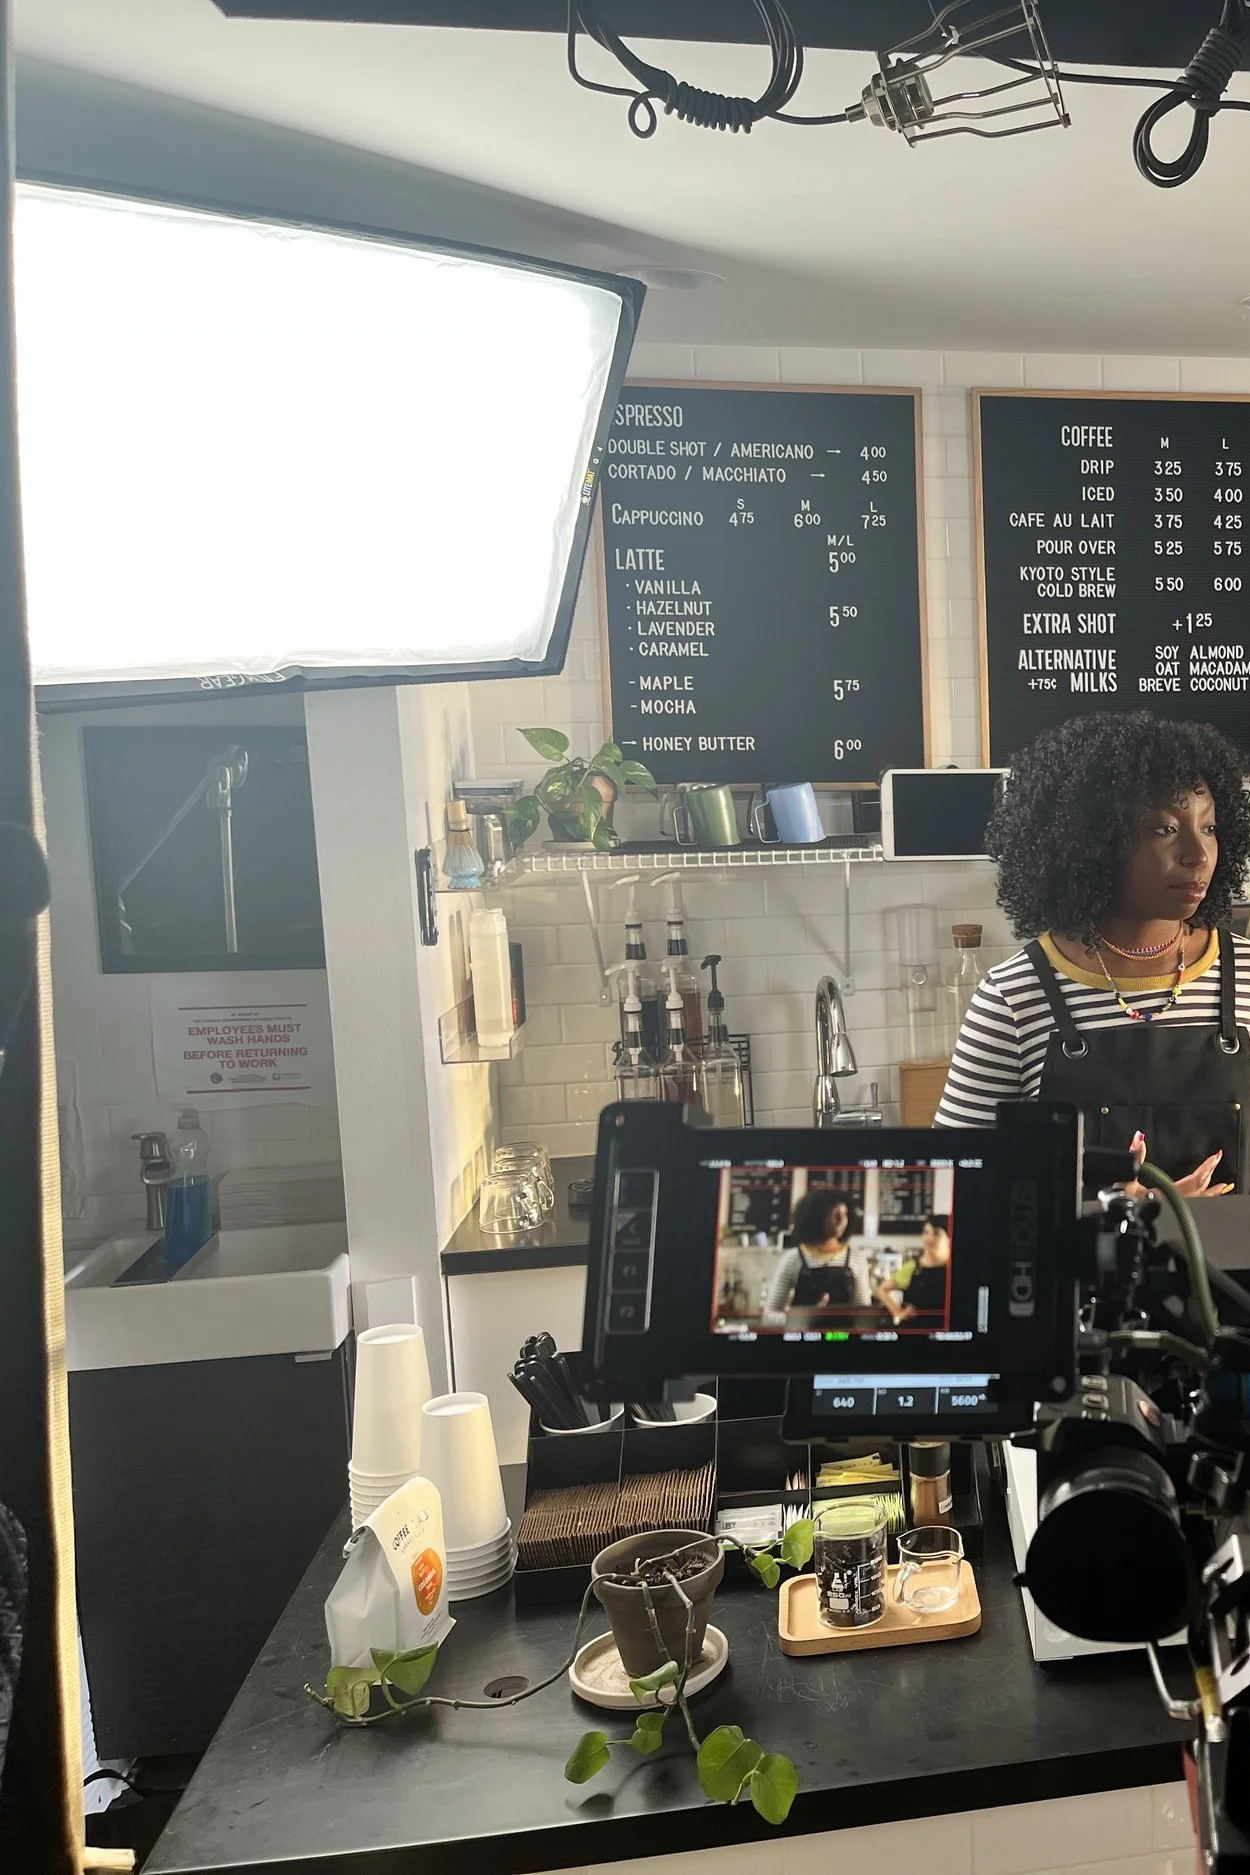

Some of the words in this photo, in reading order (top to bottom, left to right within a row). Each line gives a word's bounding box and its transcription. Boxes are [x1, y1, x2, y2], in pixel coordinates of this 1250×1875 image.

[613, 404, 682, 427] SPRESSO
[1062, 426, 1112, 447] COFFEE
[1161, 438, 1168, 448] M
[1223, 438, 1229, 449] L
[608, 439, 665, 455] DOUBLE
[670, 441, 706, 456] SHOT
[731, 443, 813, 459] AMERICANO
[608, 464, 676, 480] CORTADO
[703, 467, 786, 482] MACCHIATO
[1081, 460, 1114, 474] DRIP
[1083, 487, 1114, 501] ICED
[737, 499, 744, 509] S
[802, 500, 809, 511] M
[871, 502, 877, 512] L
[1010, 513, 1045, 527] CAFE
[1054, 514, 1071, 527] AU
[1082, 514, 1114, 528] LAIT
[828, 535, 854, 546] M/L
[1037, 540, 1072, 554] POUR
[1079, 540, 1115, 554] OVER
[616, 549, 664, 570] LATTE
[1021, 567, 1063, 580] KYOTO
[1071, 567, 1115, 581] STYLE
[635, 580, 701, 595] VANILLA
[1038, 583, 1073, 597] COLD
[1079, 584, 1116, 597] BREW
[637, 601, 712, 615] HAZELNUT
[638, 621, 714, 636] LAVENDER
[1024, 613, 1071, 634] EXTRA
[1078, 614, 1116, 633] SHOT
[639, 642, 708, 656] CARAMEL
[1019, 650, 1116, 670] ALTERNATIVE
[1156, 646, 1179, 659] SOY
[1190, 645, 1243, 659] ALMOND
[1156, 662, 1180, 675] OAT
[640, 676, 693, 690] MAPLE
[1071, 672, 1117, 692] MILKS
[1139, 678, 1181, 691] BREVE
[1190, 677, 1248, 691] COCONUT
[641, 700, 696, 714] MOCHA
[643, 737, 692, 751] HONEY
[699, 737, 755, 750] BUTTER
[188, 1025, 264, 1036] EMPLOYEES
[267, 1024, 301, 1033] MUST
[207, 1036, 244, 1045] WASH
[247, 1034, 290, 1044] HANDS
[183, 1050, 232, 1060] BEFORE
[235, 1047, 308, 1058] RETURNING
[218, 1060, 235, 1069] TO
[239, 1058, 277, 1068] WORK
[832, 1396, 855, 1409] 640
